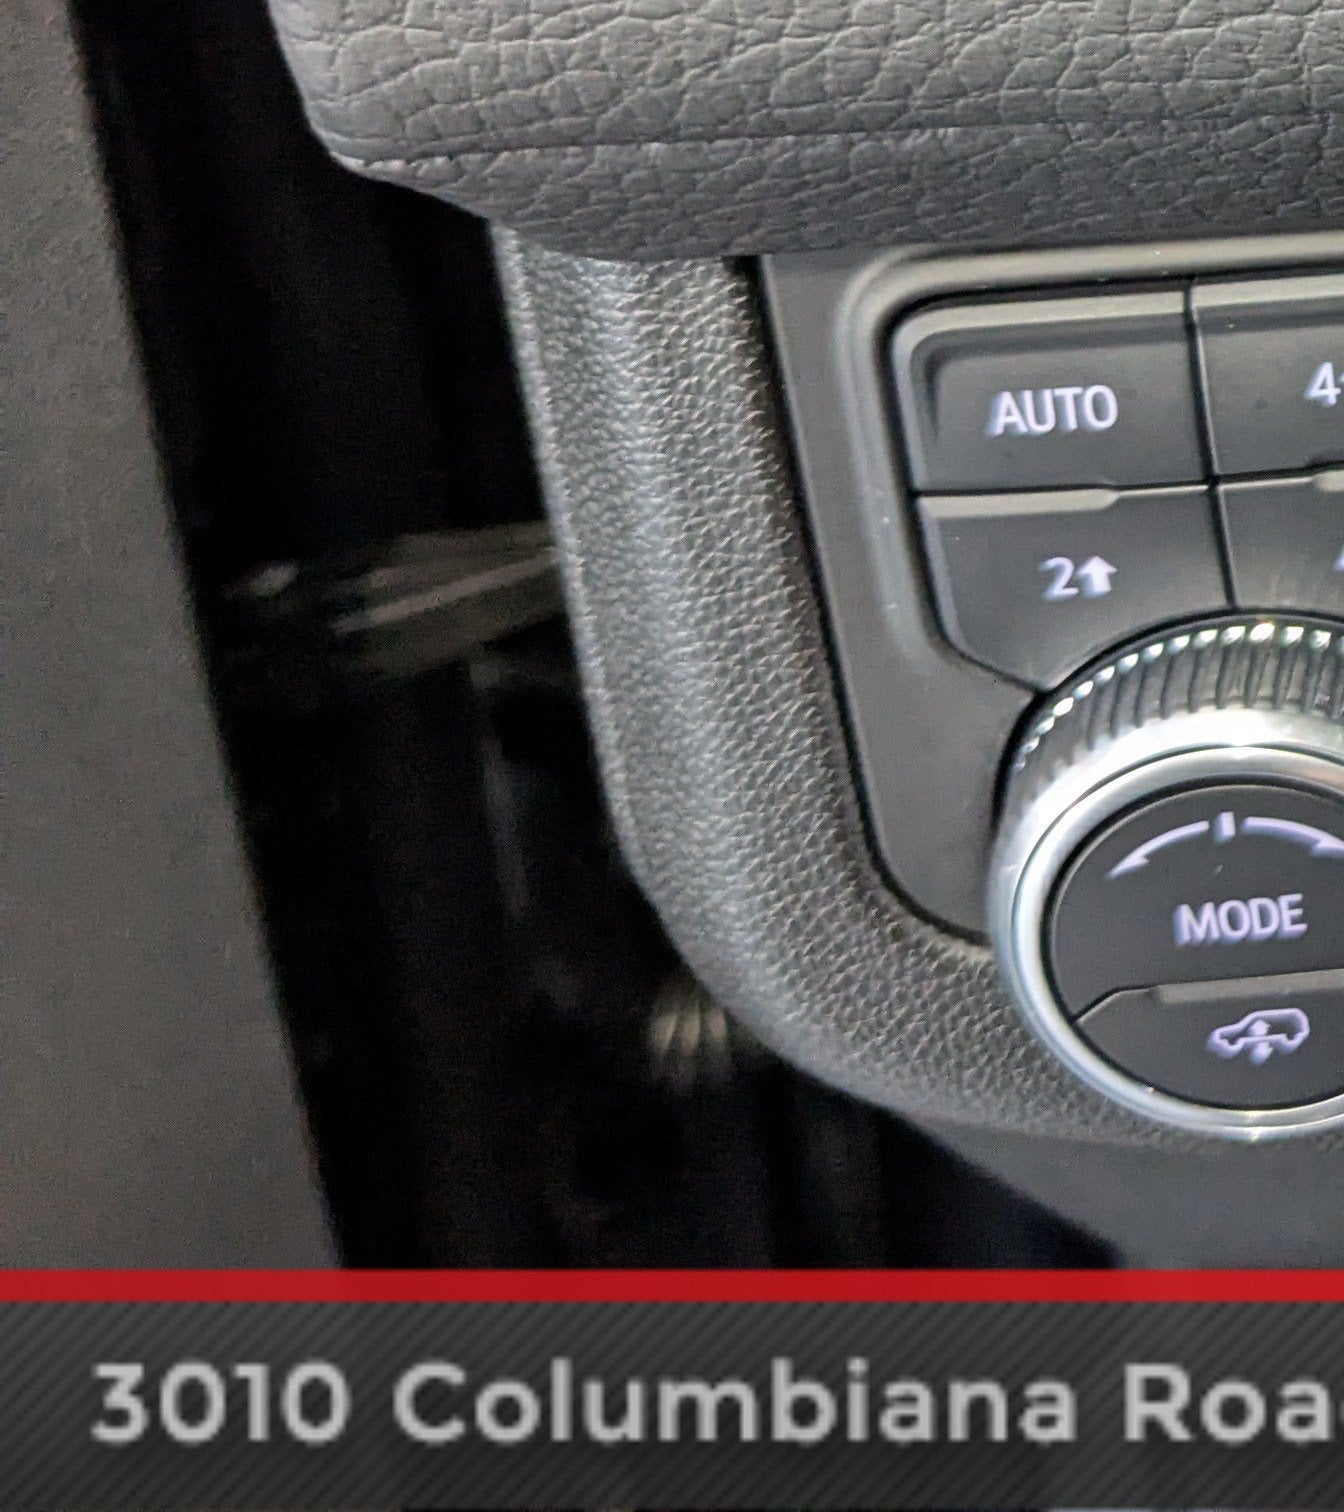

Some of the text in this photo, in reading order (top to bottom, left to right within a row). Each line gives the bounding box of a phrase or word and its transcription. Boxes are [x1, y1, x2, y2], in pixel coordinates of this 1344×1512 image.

[1305, 361, 1342, 406] 4
[989, 384, 1119, 436] AUTO
[1043, 556, 1078, 600] 2
[1174, 893, 1308, 946] MODE
